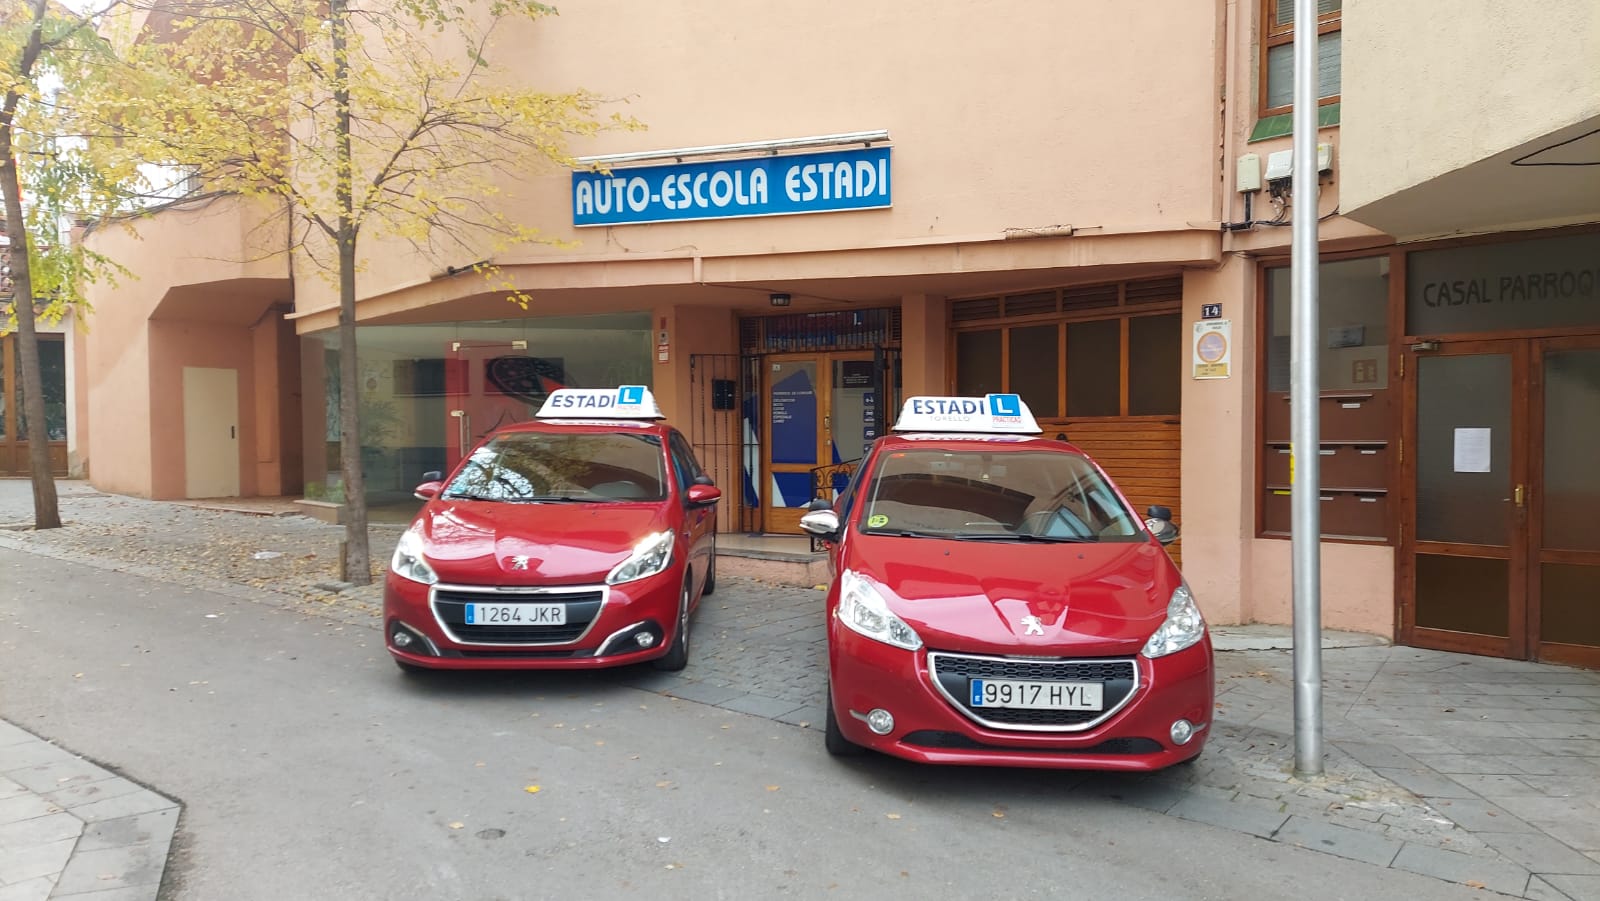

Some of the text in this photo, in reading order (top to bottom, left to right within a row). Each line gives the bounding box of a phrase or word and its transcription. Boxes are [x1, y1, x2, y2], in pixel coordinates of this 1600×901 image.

[576, 159, 887, 215] AUTO-ESCOLA ESTADI
[1423, 268, 1600, 308] CASAL PARROQ
[1204, 306, 1219, 316] 14
[551, 394, 617, 408] ESTADI
[622, 388, 637, 403] L
[913, 399, 985, 415] ESTADI
[997, 397, 1013, 414] L
[481, 607, 522, 622] 1264
[529, 607, 561, 622] JKR
[985, 683, 1042, 705] 9917
[1050, 685, 1092, 706] HYL
